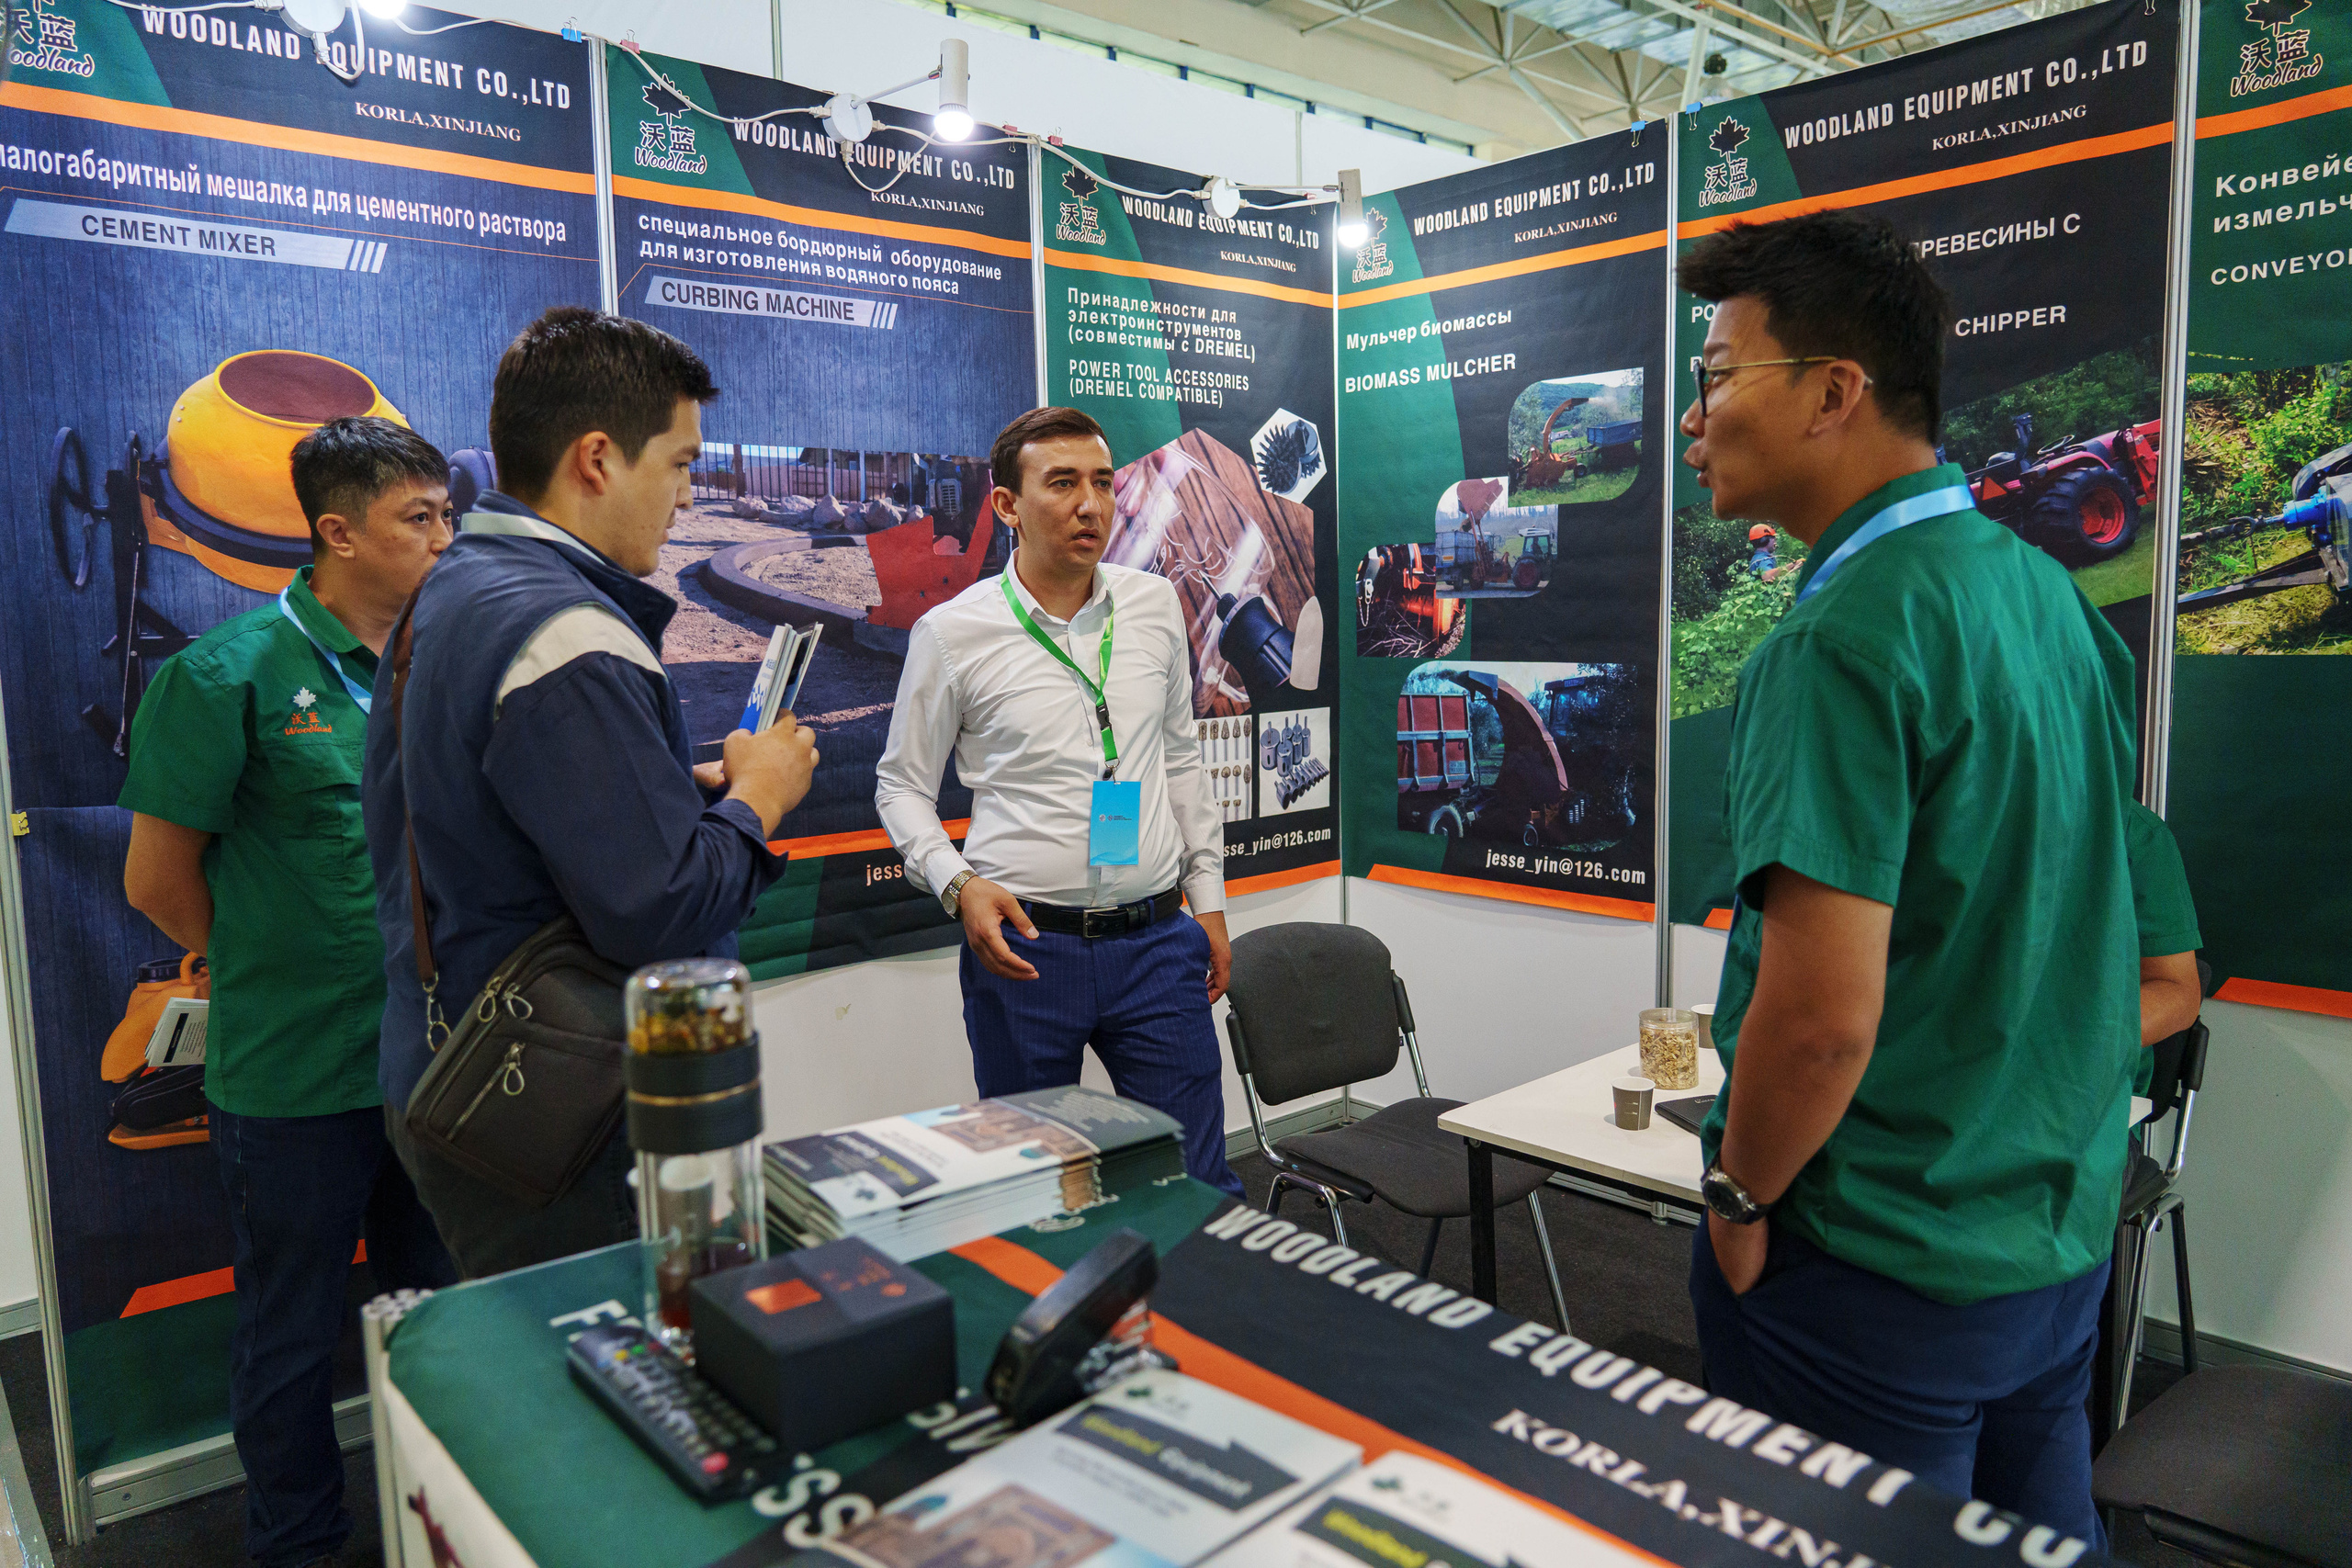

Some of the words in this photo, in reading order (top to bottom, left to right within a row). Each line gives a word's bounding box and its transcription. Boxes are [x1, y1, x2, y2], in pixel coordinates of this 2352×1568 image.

[8, 46, 96, 78] oodland
[141, 4, 300, 61] WOODLAND
[316, 41, 463, 89] QUIPMENT
[476, 68, 571, 109] CO.,LTD
[2240, 29, 2311, 73] 沃蓝
[2230, 52, 2324, 97] Woodland
[1784, 101, 1894, 150] WOODLAND
[1904, 66, 2033, 123] EQUIPMENT
[2045, 39, 2148, 89] CO.,LTD
[355, 102, 522, 141] KORLA,XINJIANG
[639, 121, 697, 155] 沃蓝
[1931, 104, 2087, 152] KORLA,XINJIANG
[634, 147, 707, 175] Woodland
[733, 117, 836, 159] WOODLAND
[849, 142, 944, 178] QUIPMENT
[951, 160, 1015, 190] CO.,LTD
[1704, 157, 1748, 189] 沃蓝
[207, 174, 308, 209] мешалка
[312, 186, 351, 216] для
[356, 194, 475, 231] цементного
[480, 210, 567, 245] раствора
[870, 191, 985, 217] KORLA,XINJIANG
[1414, 201, 1488, 236] WOODLAND
[1495, 179, 1580, 218] EQUIPMENT
[1589, 162, 1655, 197] CO.,LTD
[1699, 177, 1758, 208] Woodland
[1059, 202, 1099, 230] 沃蓝
[1122, 196, 1193, 229] WOODLAND
[1198, 212, 1273, 240] EQUIPMENT
[1278, 223, 1319, 250] CO.,LTD
[1514, 211, 1618, 243] KORLA,XINJIANG
[82, 214, 191, 247] CEMENT
[199, 229, 276, 257] MIXER
[639, 214, 774, 247] специальное
[777, 231, 882, 264] бордюрный
[890, 248, 1002, 281] оборудование
[1057, 224, 1106, 245] Woodland
[639, 239, 679, 263] для
[683, 246, 821, 276] изготовления
[826, 264, 908, 288] водяного
[911, 276, 959, 296] пояса
[1220, 251, 1296, 273] KORLA,XINJIANG
[1352, 260, 1394, 283] Woodland
[1356, 243, 1387, 268] 沃蓝
[2211, 247, 2352, 286] CONVEYO
[661, 281, 759, 312] CURBING
[765, 294, 854, 321] MACHINE
[1068, 288, 1206, 320] Принадлежности
[1211, 308, 1237, 324] для
[1068, 310, 1242, 342] электроинструментов
[1346, 326, 1417, 352] Мульчер
[1420, 310, 1512, 338] биомассы
[1955, 305, 2067, 337] CHIPPER
[1069, 325, 1175, 352] (совместимы
[1195, 338, 1256, 363] DREMEL)
[1069, 359, 1121, 379] POWER
[1126, 364, 1159, 383] TOOL
[1165, 367, 1250, 391] ACCESSORIES
[1345, 367, 1420, 393] BIOMASS
[1426, 353, 1516, 383] MULCHER
[1069, 378, 1134, 399] (DREMEL
[1138, 382, 1223, 409] COMPATIBLE)
[285, 723, 333, 736] Woodland
[1224, 828, 1331, 857] sse_yin@126.com
[1486, 849, 1645, 885] jesse_yin@126.com
[1203, 1203, 1496, 1329] WOODLAND
